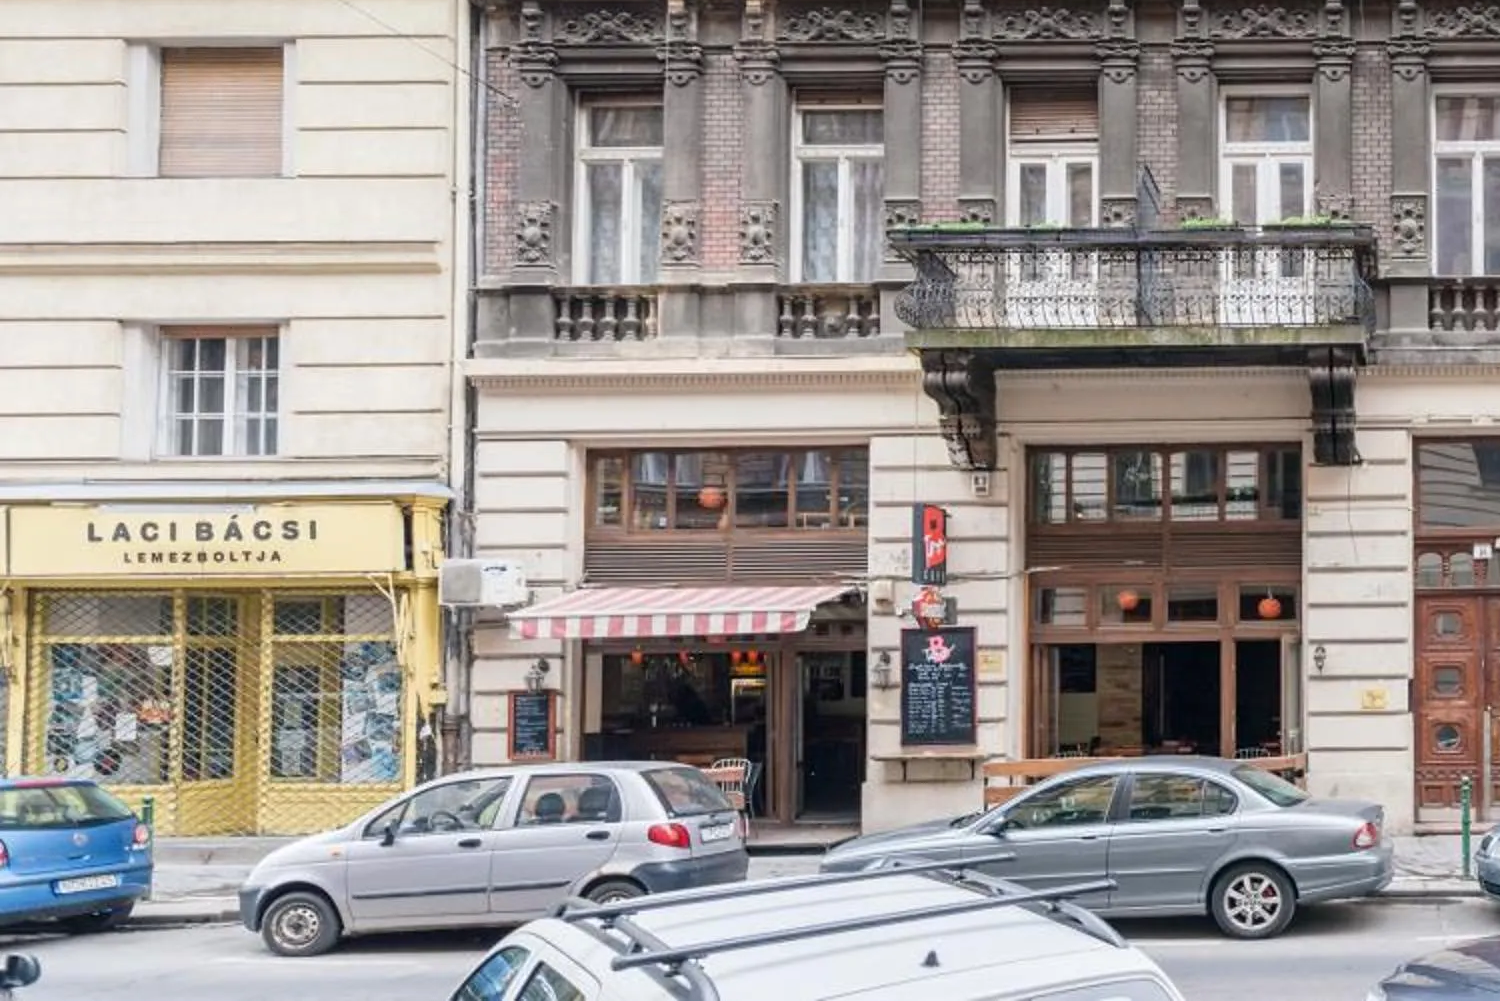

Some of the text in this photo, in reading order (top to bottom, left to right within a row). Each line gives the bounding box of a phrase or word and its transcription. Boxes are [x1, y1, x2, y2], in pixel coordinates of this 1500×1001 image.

[87, 514, 317, 542] LACI BÁCSI
[123, 551, 282, 564] LEMEZBOLTJA
